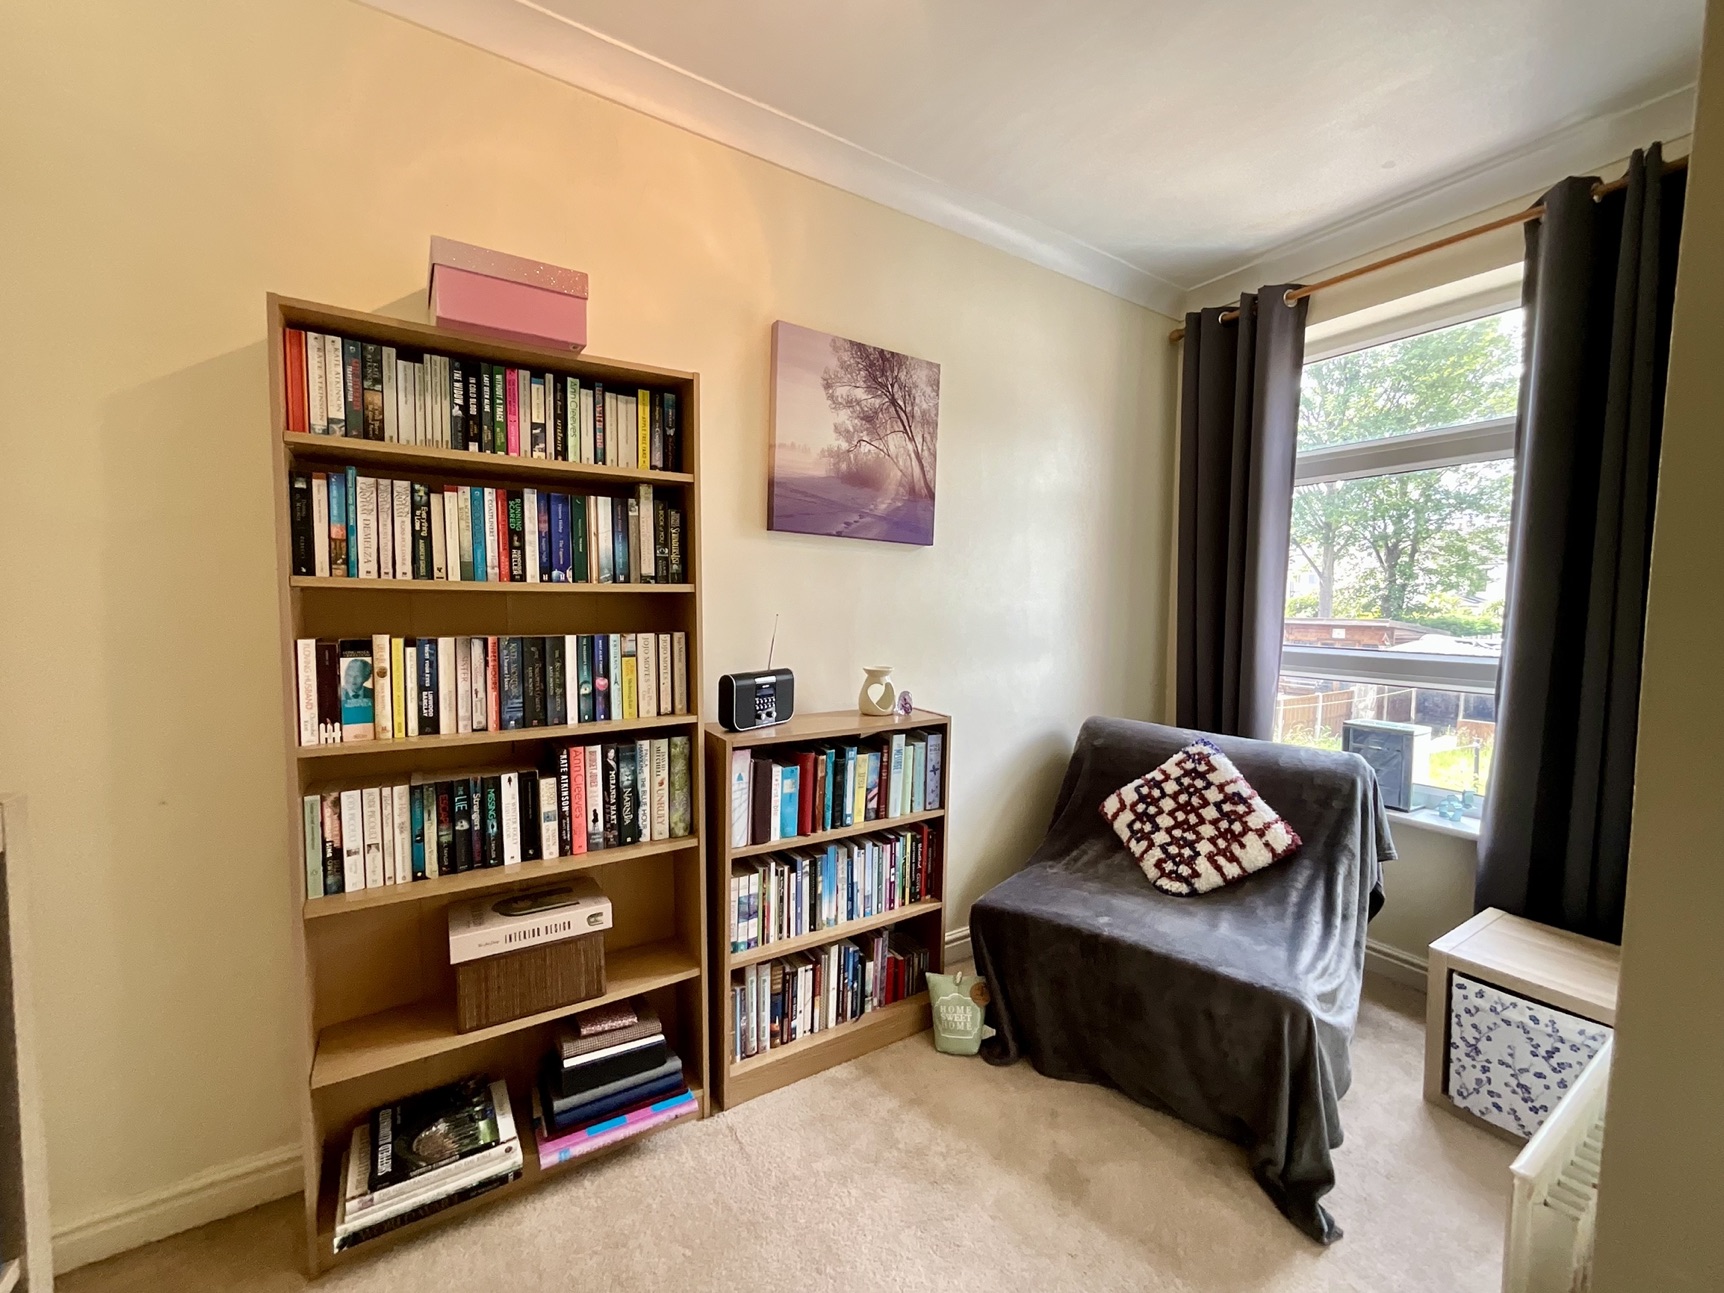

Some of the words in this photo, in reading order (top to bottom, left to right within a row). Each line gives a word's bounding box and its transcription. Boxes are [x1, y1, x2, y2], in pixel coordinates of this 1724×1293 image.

[454, 370, 462, 381] THE
[454, 382, 464, 405] WIDOW
[469, 384, 477, 398] COLD
[570, 381, 578, 399] Ann
[469, 398, 477, 415] BLOOD
[496, 404, 504, 422] TRACE
[420, 507, 428, 537] Everything
[363, 518, 372, 564] DEMELZA
[642, 637, 650, 655] JOJO
[460, 656, 469, 683] SISTER
[304, 675, 313, 710] HUSBAND
[560, 755, 568, 773] KATE
[573, 750, 583, 772] Ann
[590, 771, 598, 788] JONES
[609, 770, 617, 804] MIRANDA
[366, 792, 375, 809] JODI
[455, 795, 468, 812] LIE
[488, 789, 496, 819] MISSING
[561, 775, 569, 812] ATKINSON
[574, 774, 584, 819] Cleeves
[472, 793, 481, 831] Strangers
[622, 788, 633, 825] NARNIA
[656, 788, 665, 826] UNRULY
[368, 810, 377, 840] PICOULT
[504, 928, 540, 944] INTERIOR
[545, 921, 571, 935] DESIGN
[940, 1006, 972, 1014] HOME
[940, 1013, 972, 1021] SWEET
[941, 1021, 972, 1030] HOME
